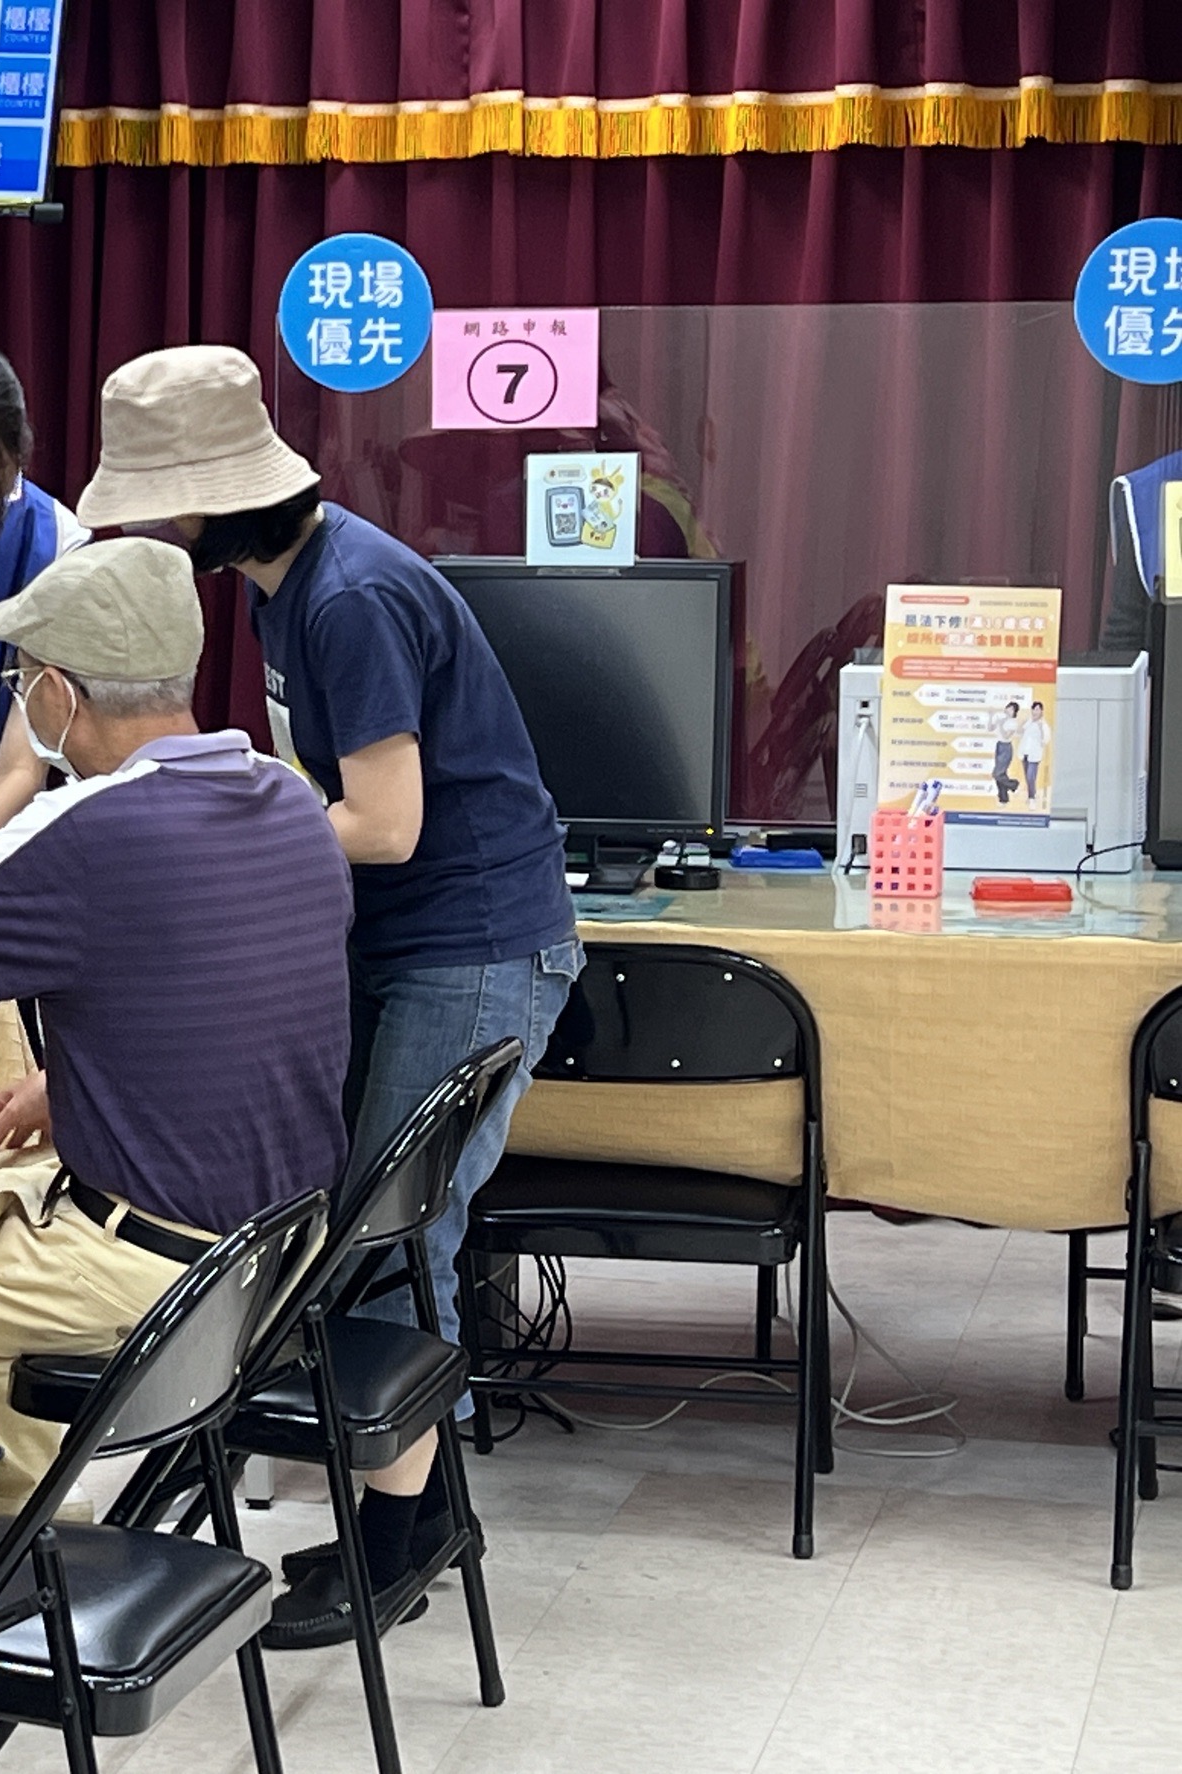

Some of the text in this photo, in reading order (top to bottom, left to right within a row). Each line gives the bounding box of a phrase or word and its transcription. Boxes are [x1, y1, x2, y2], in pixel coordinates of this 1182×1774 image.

[4, 34, 47, 44] COUNTER
[308, 261, 404, 309] 現場
[306, 317, 403, 366] 優先
[464, 318, 567, 337] 網路申報
[496, 364, 529, 405] 7
